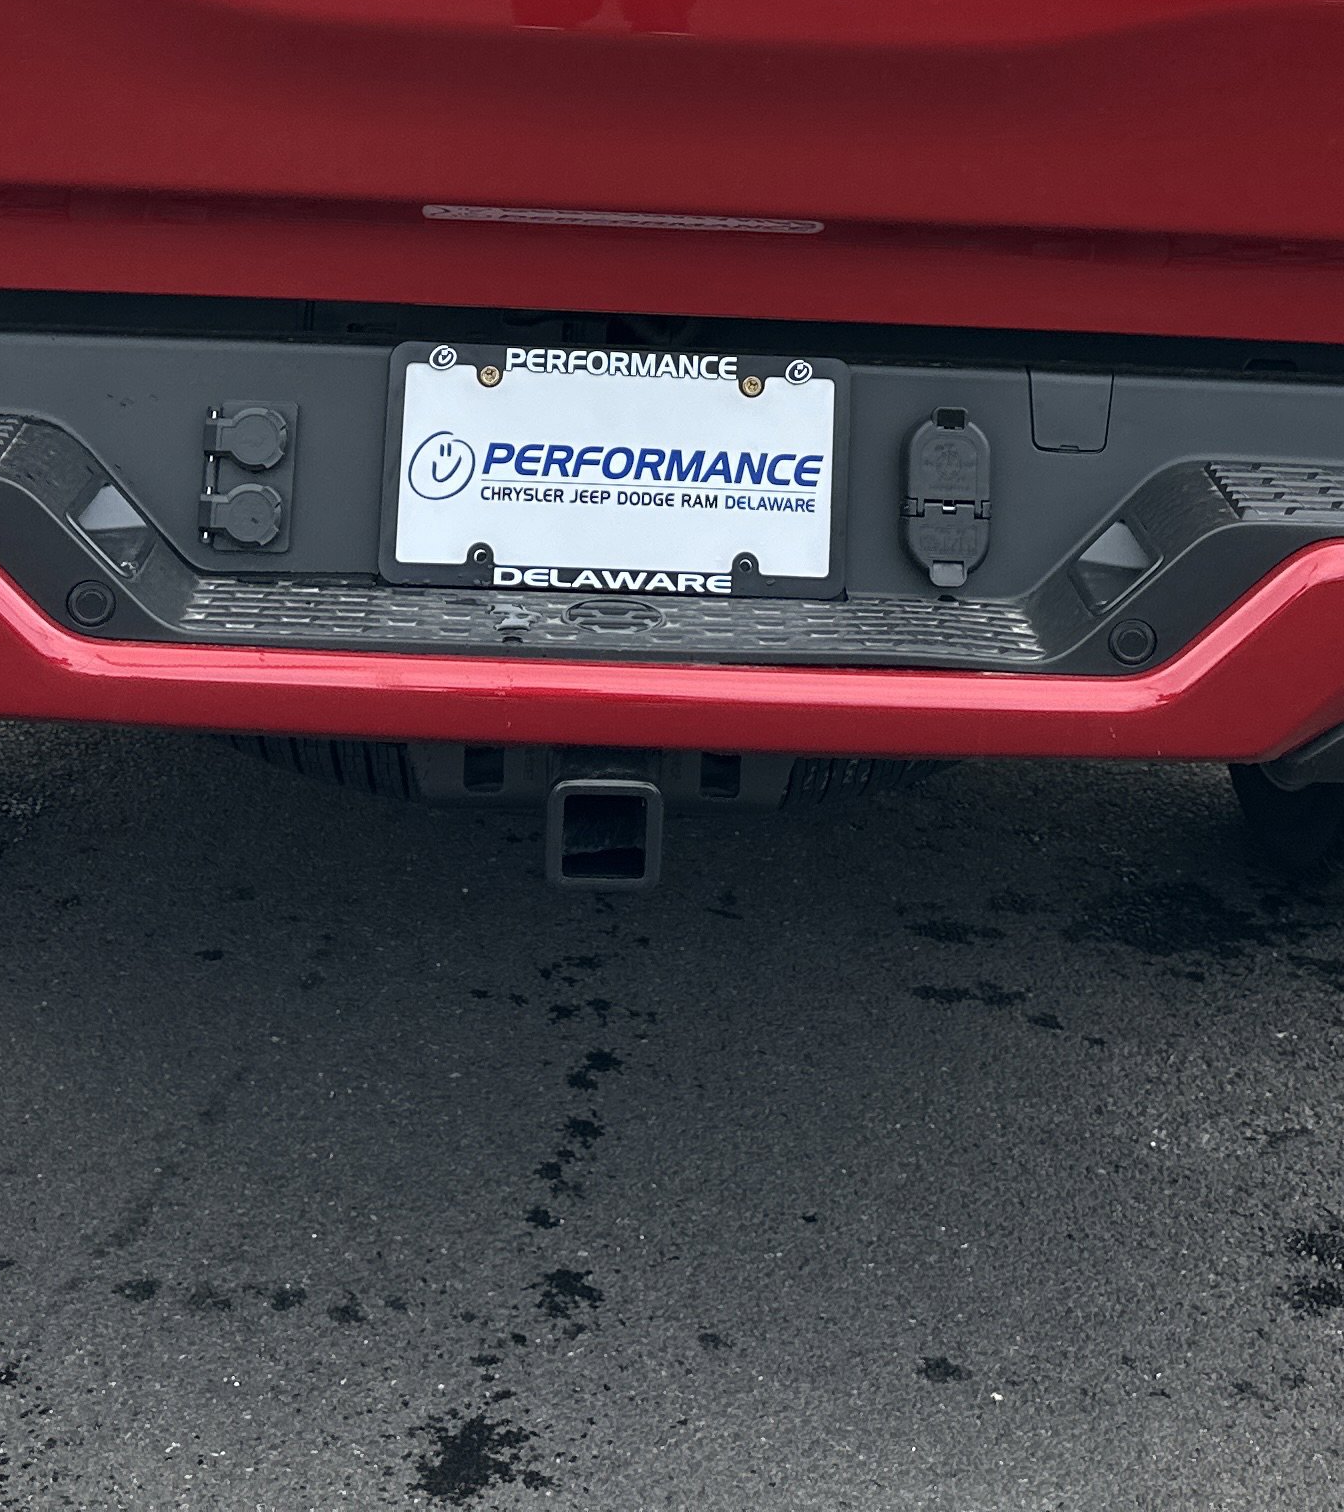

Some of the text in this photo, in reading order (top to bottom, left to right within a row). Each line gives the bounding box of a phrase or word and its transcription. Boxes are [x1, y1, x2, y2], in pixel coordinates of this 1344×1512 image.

[505, 347, 738, 381] PERFORMANCE
[482, 442, 824, 487] PERFORMANCE
[480, 486, 816, 513] CHRYSLER JEEP DODGE RAM DELAWARE
[493, 567, 732, 594] DELAWARE
